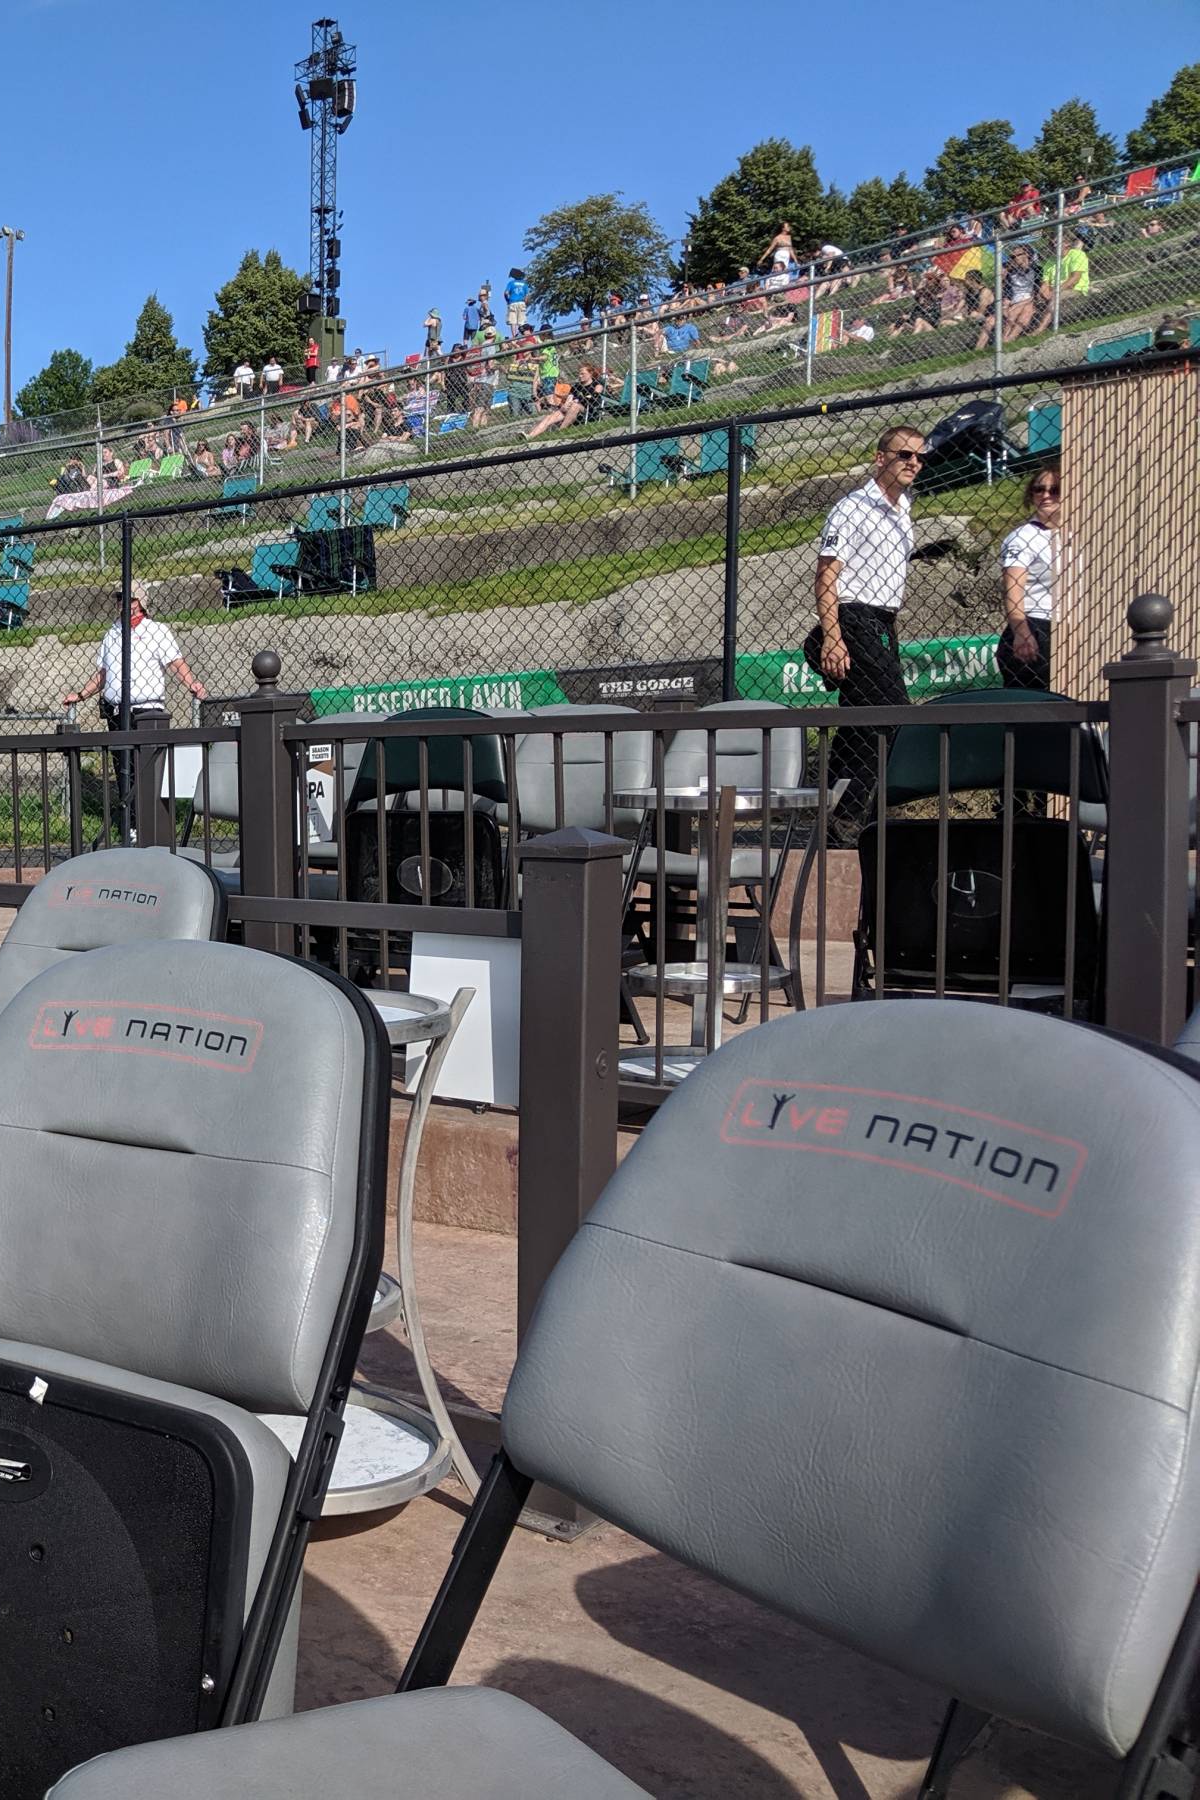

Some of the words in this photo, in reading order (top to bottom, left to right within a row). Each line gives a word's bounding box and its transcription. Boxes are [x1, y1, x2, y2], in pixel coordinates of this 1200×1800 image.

[599, 681, 634, 693] THE
[636, 677, 695, 691] GORGE
[98, 888, 158, 906] NATION
[125, 1019, 247, 1056] NATION
[865, 1114, 1060, 1192] NATION
